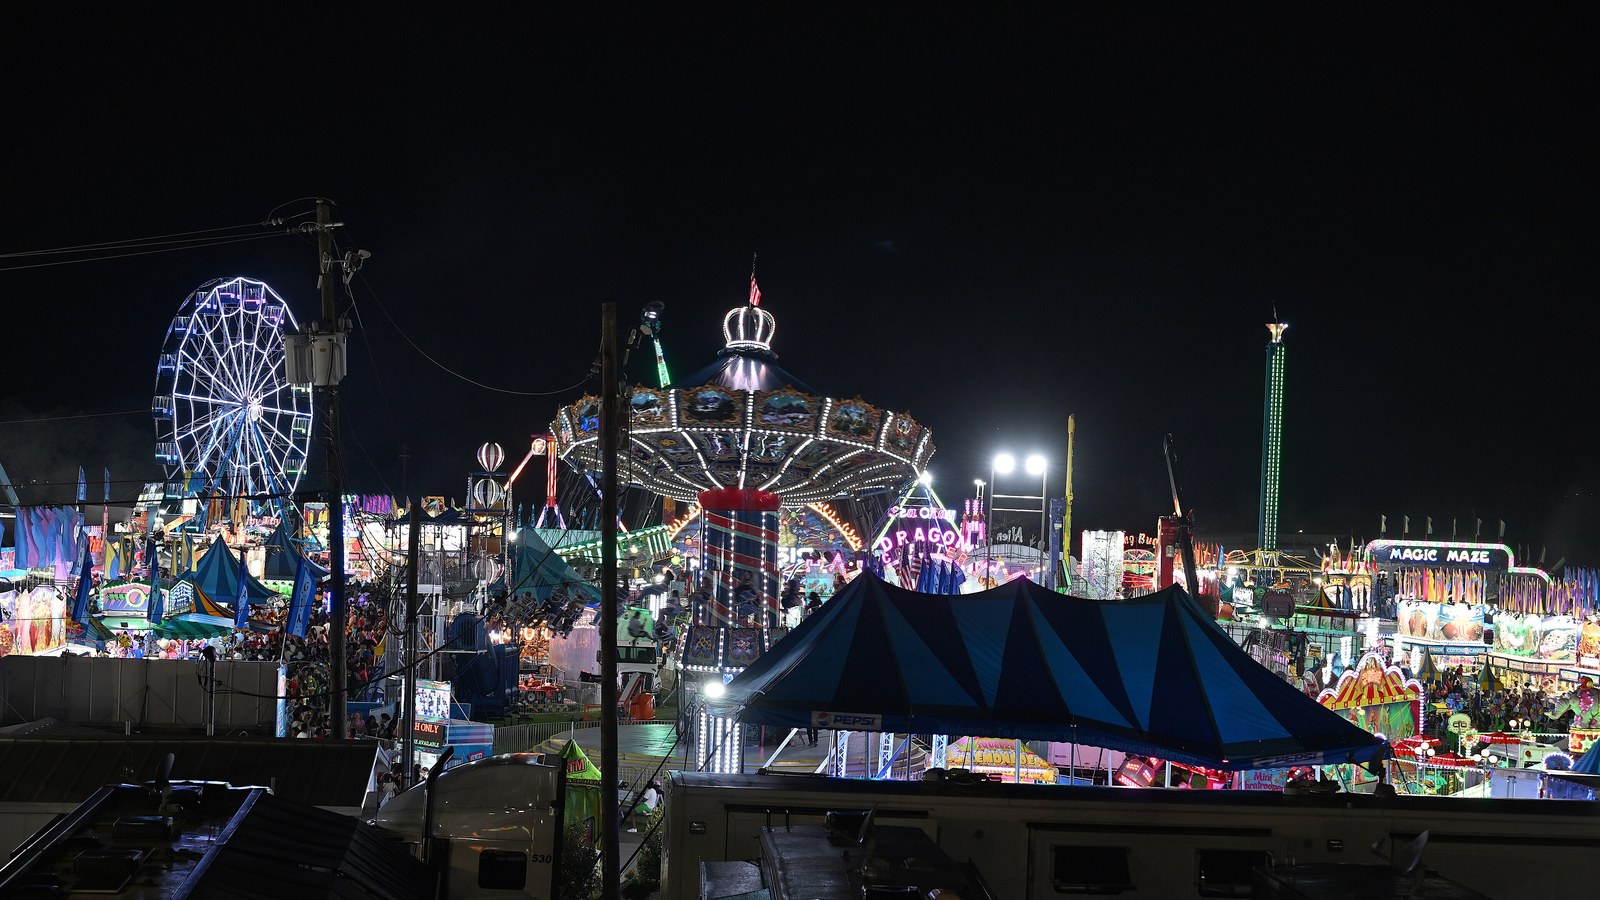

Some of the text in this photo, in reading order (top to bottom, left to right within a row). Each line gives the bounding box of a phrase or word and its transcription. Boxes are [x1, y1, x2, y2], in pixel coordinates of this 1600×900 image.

[1390, 549, 1490, 563] MAGIC MAZE
[833, 715, 875, 726] PEPSI
[421, 723, 439, 733] ONLY
[565, 758, 585, 773] TM
[1254, 772, 1272, 782] Mini
[532, 854, 552, 863] 530
